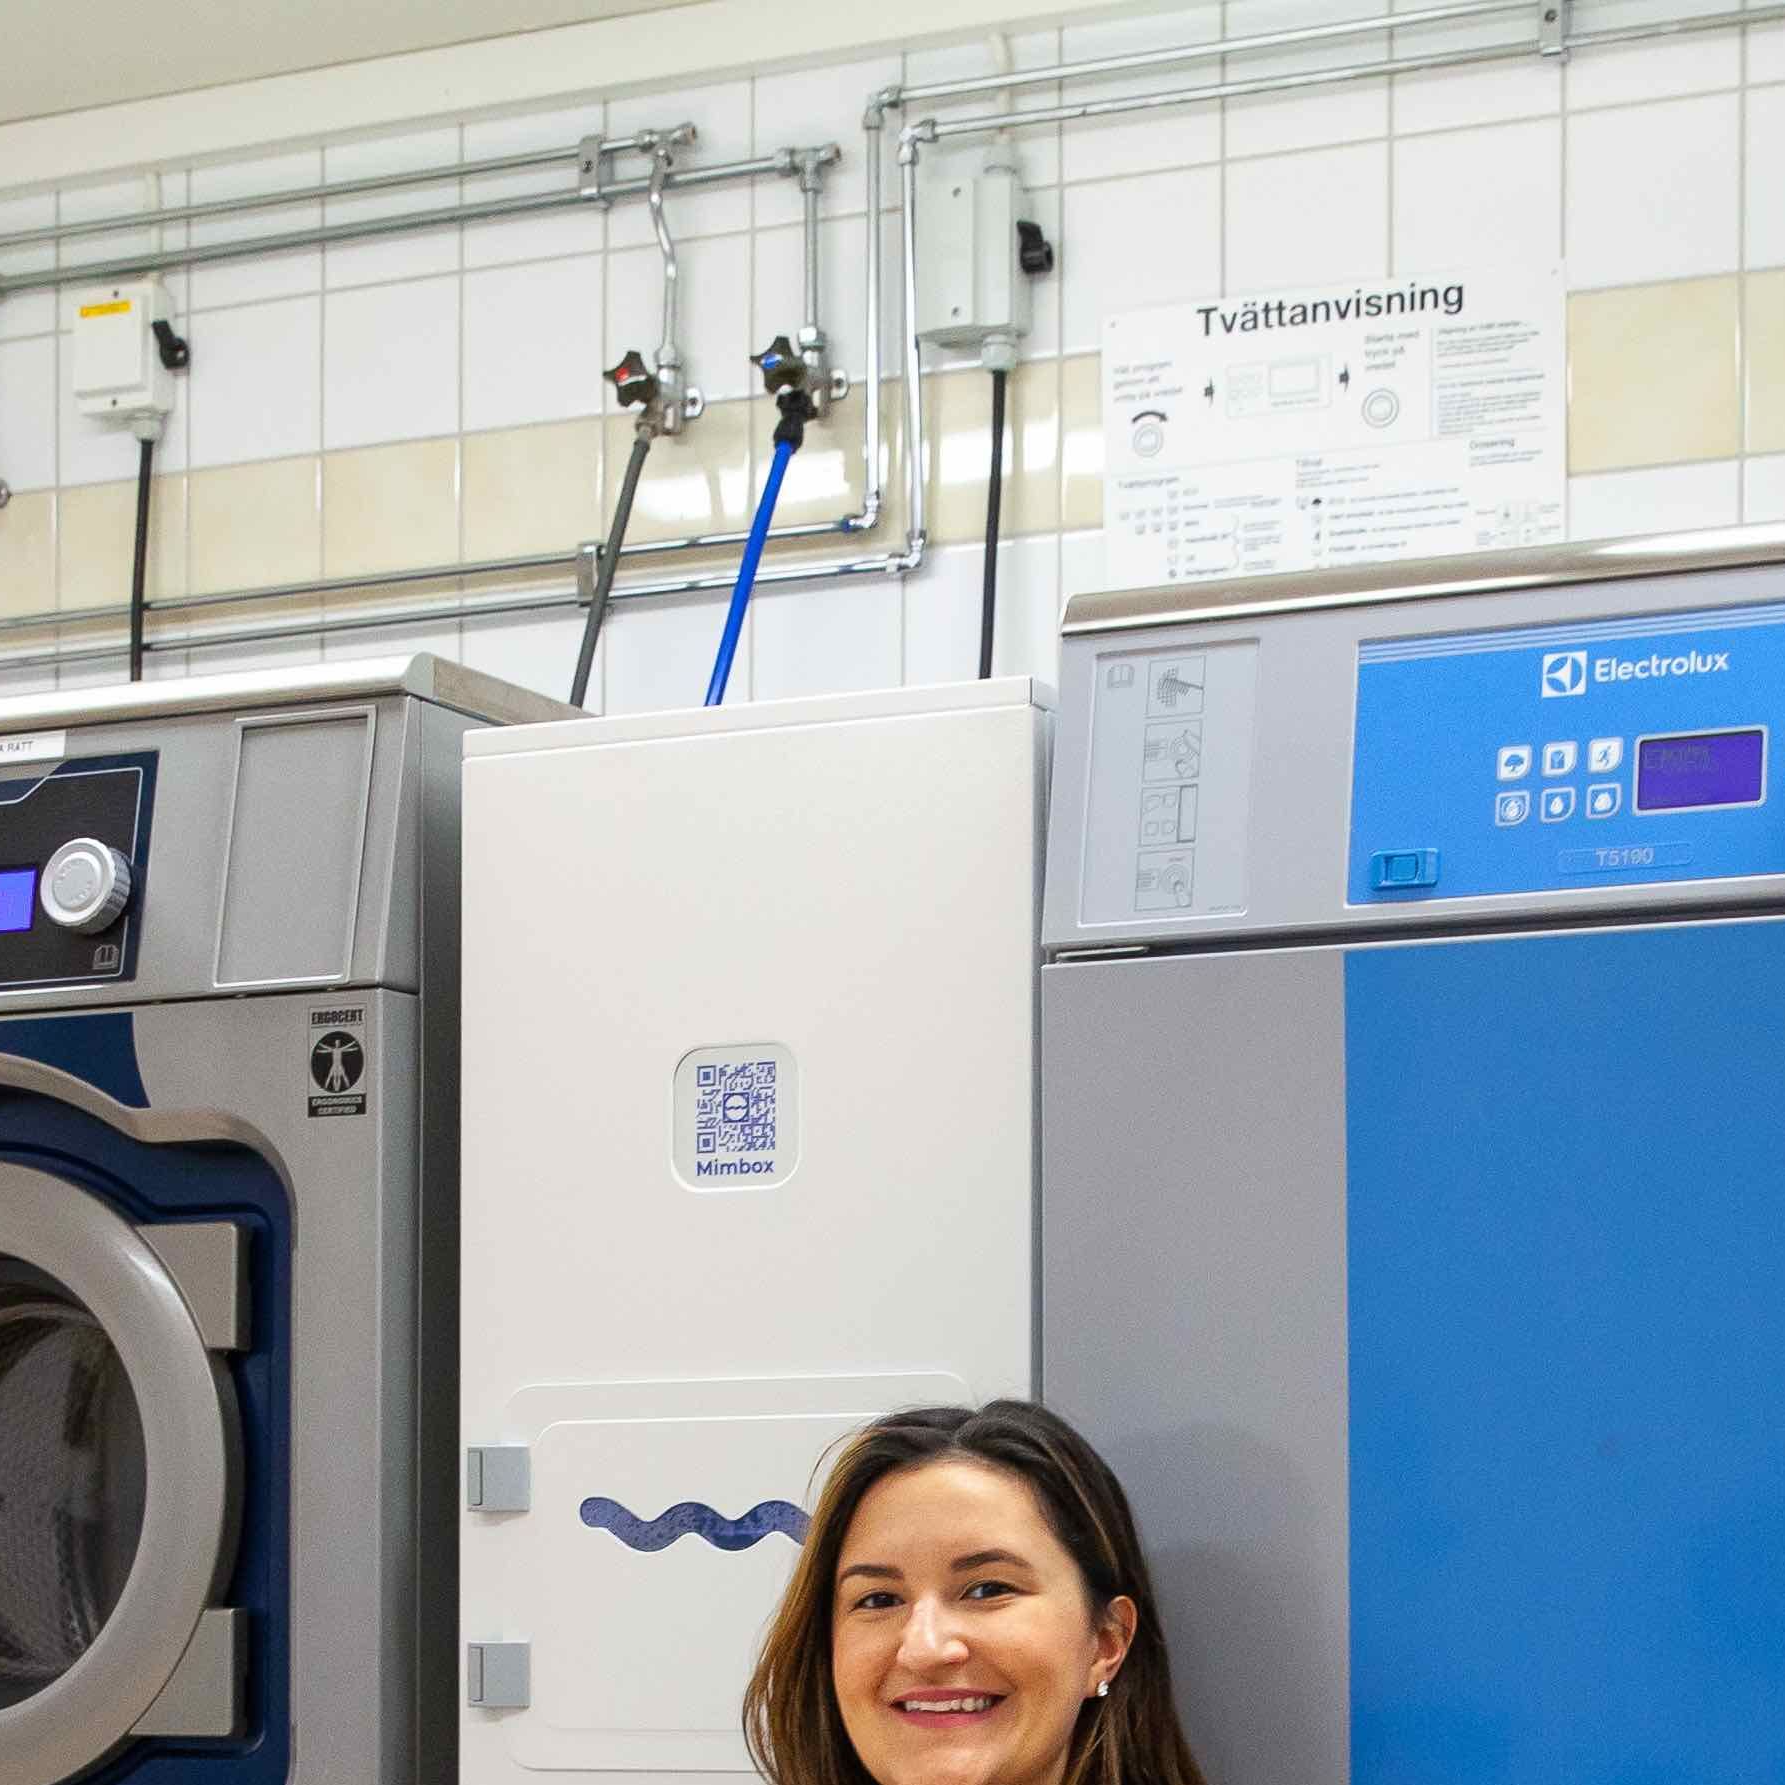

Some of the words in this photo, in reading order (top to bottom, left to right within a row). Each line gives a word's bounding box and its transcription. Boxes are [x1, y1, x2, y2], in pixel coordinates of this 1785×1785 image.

[1196, 283, 1464, 337] Tvättanvisning
[1594, 650, 1730, 683] Electrolux
[696, 1158, 775, 1177] Mimbox
